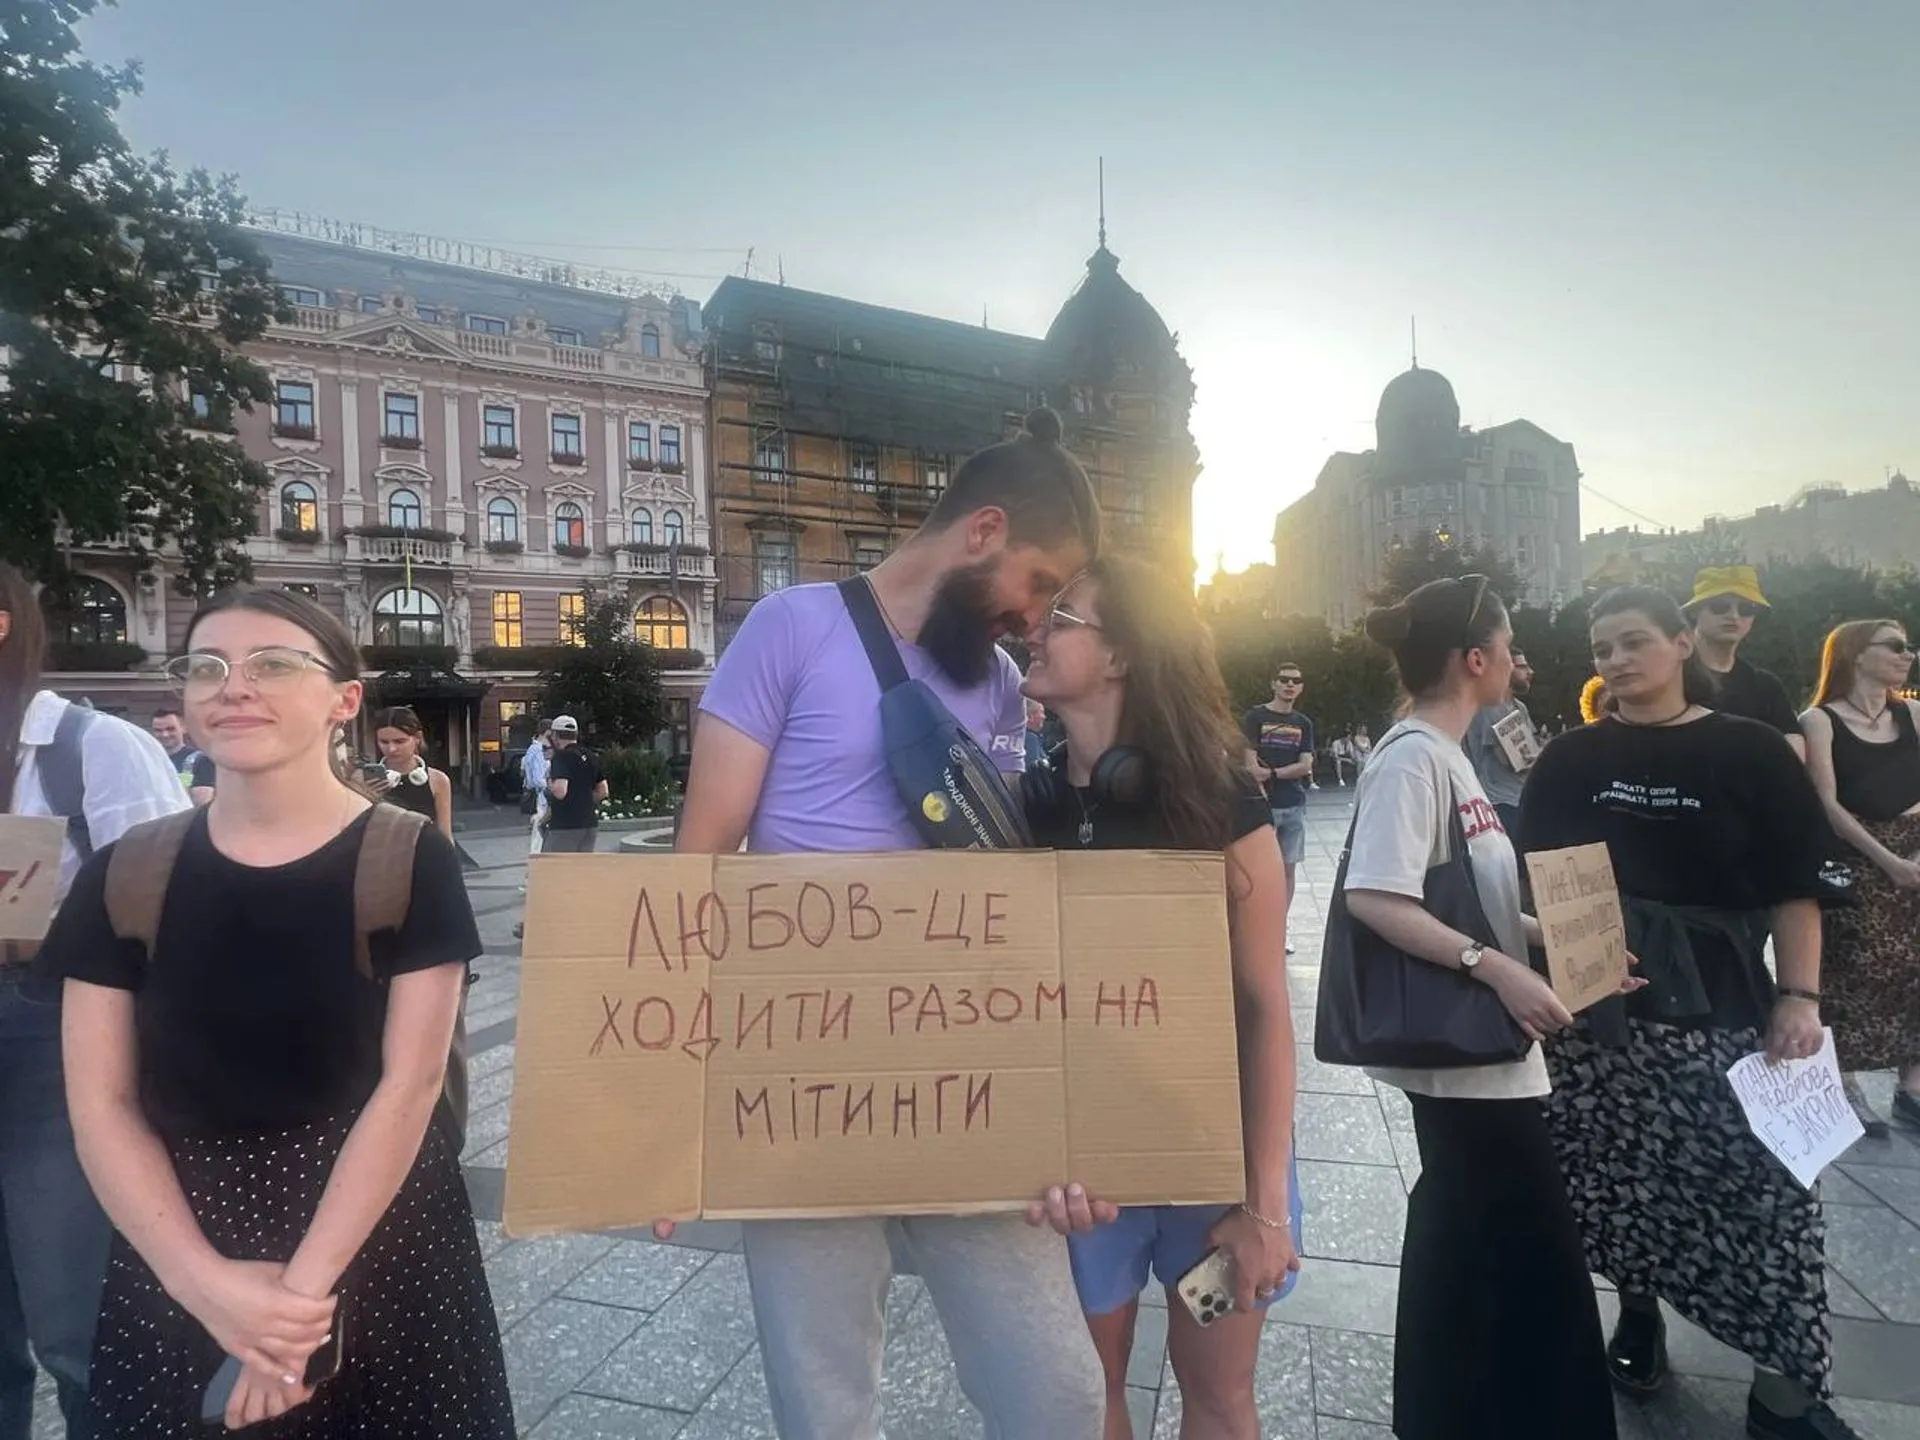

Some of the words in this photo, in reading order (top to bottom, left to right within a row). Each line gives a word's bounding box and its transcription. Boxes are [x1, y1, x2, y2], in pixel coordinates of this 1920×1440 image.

[588, 991, 854, 1062] ХОДИТИ
[887, 980, 1068, 1036] РАЗОМ
[1094, 976, 1161, 1028] НА
[734, 1071, 994, 1145] МІТИНГИ
